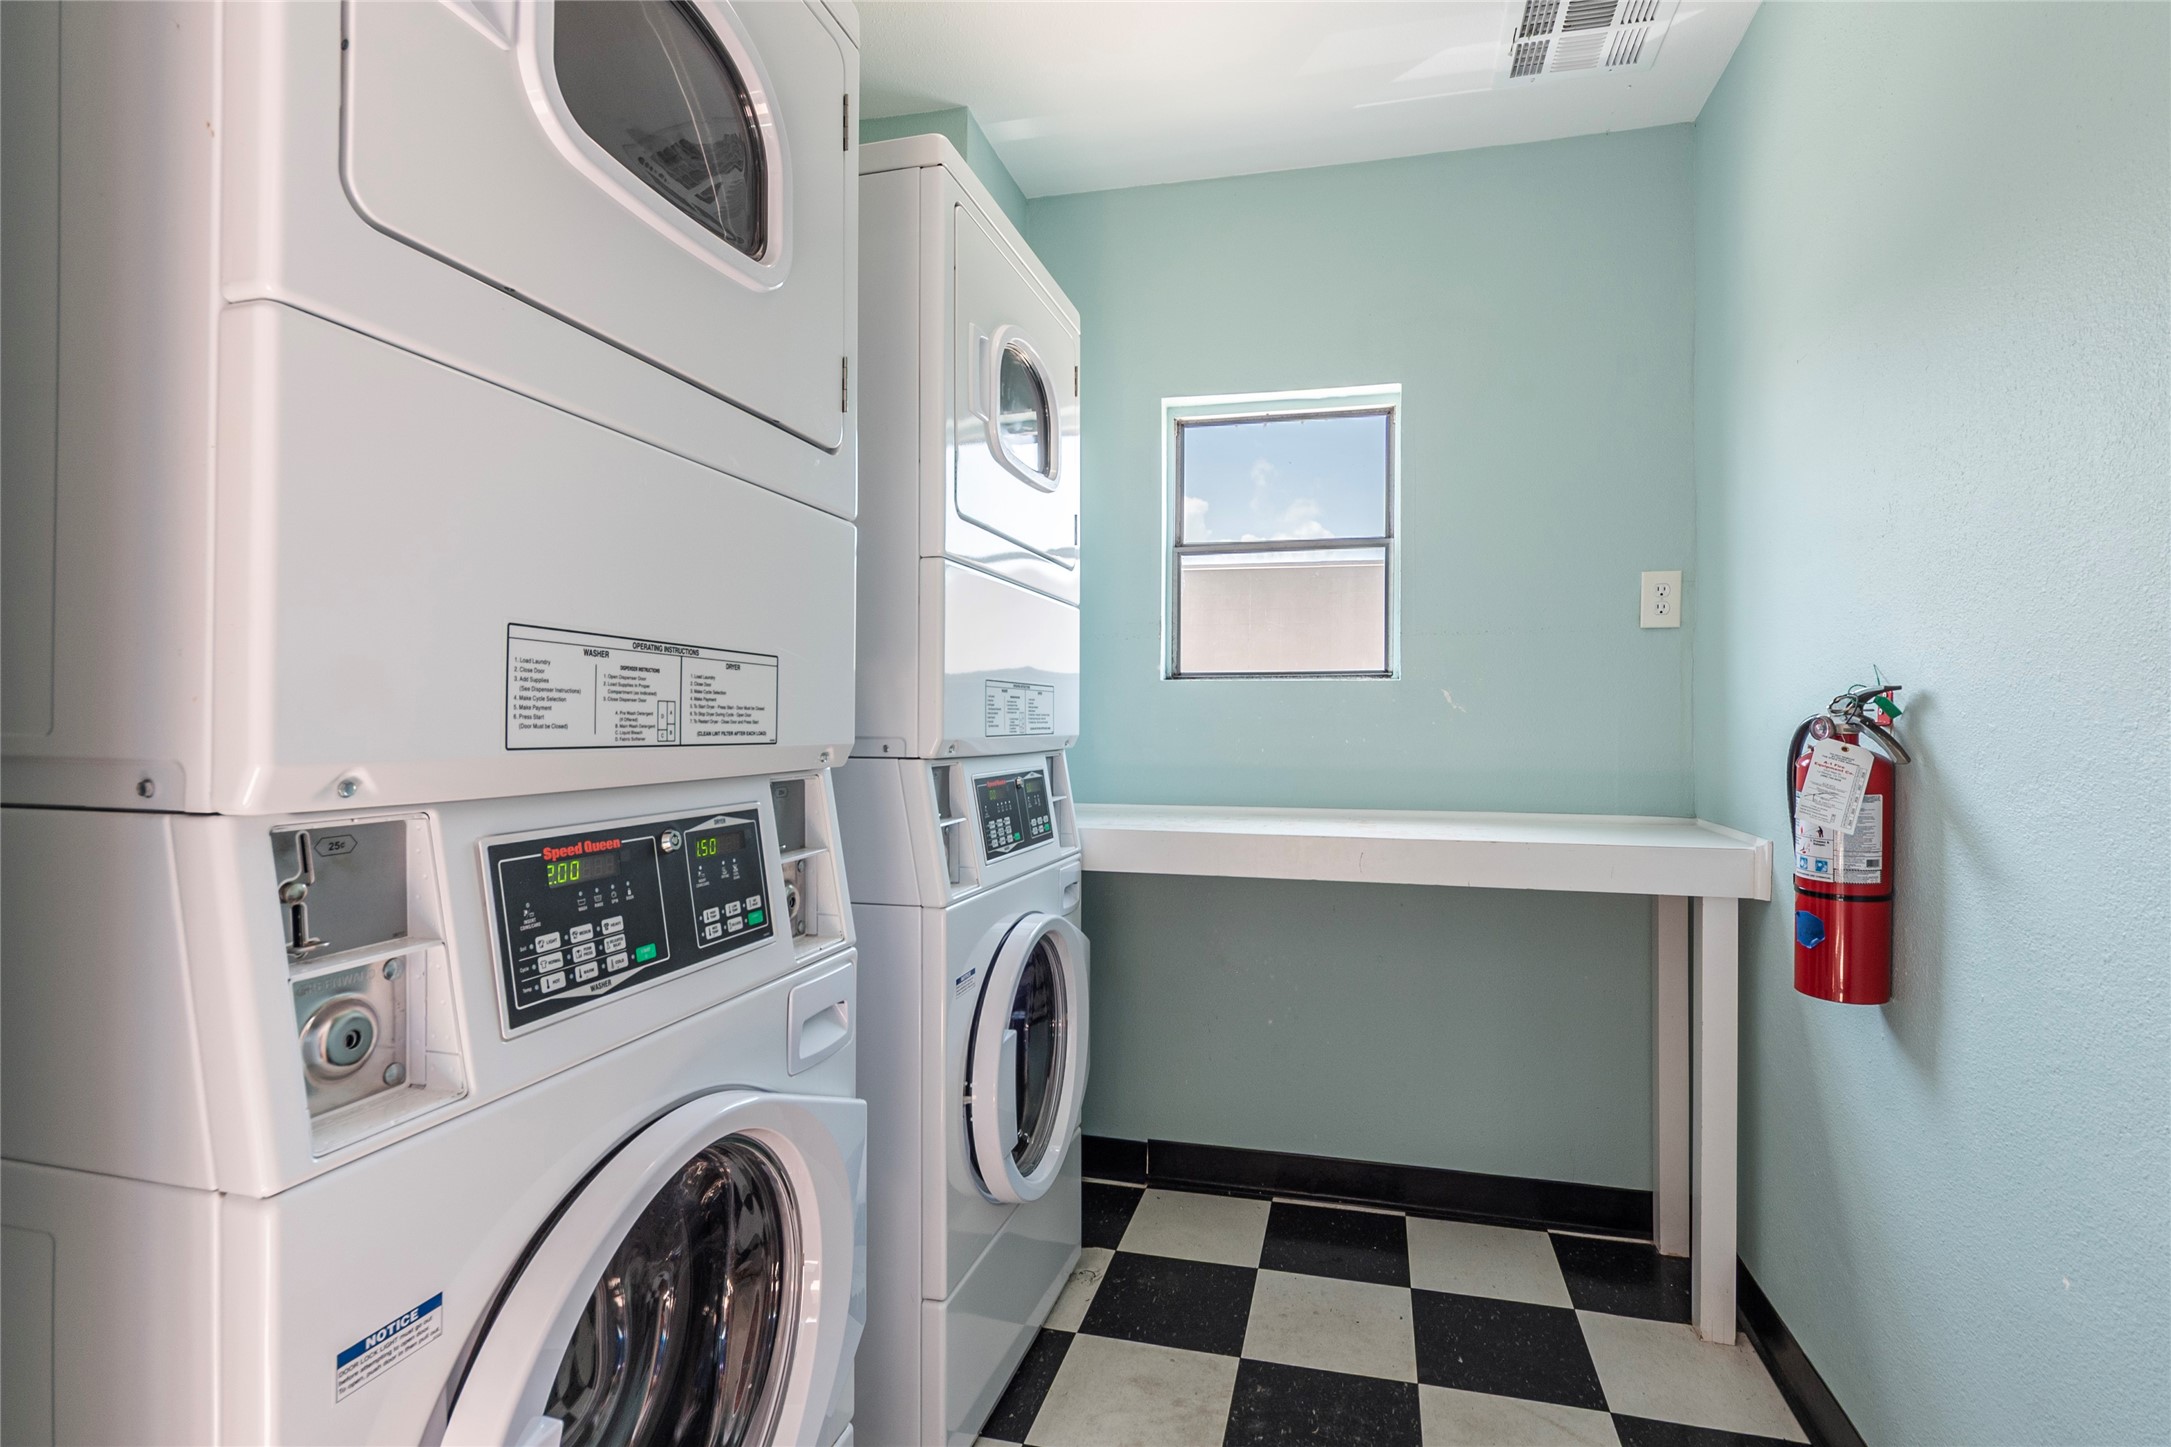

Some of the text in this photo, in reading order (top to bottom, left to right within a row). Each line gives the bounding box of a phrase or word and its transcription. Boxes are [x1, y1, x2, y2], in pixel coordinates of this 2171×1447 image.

[583, 649, 610, 658] WASHER
[632, 642, 699, 656] OPERATING INSTRUCTIONS
[532, 658, 551, 666] Laundry
[543, 839, 620, 861] Speed Queen
[590, 980, 612, 991] WASHER
[365, 1308, 419, 1349] NOTICE
[338, 1316, 432, 1378] DOOR LOCK LIGHT must go out
[339, 1370, 359, 1386] before
[360, 1349, 392, 1372] attempting
[401, 1335, 415, 1347] open
[367, 1365, 382, 1378] push
